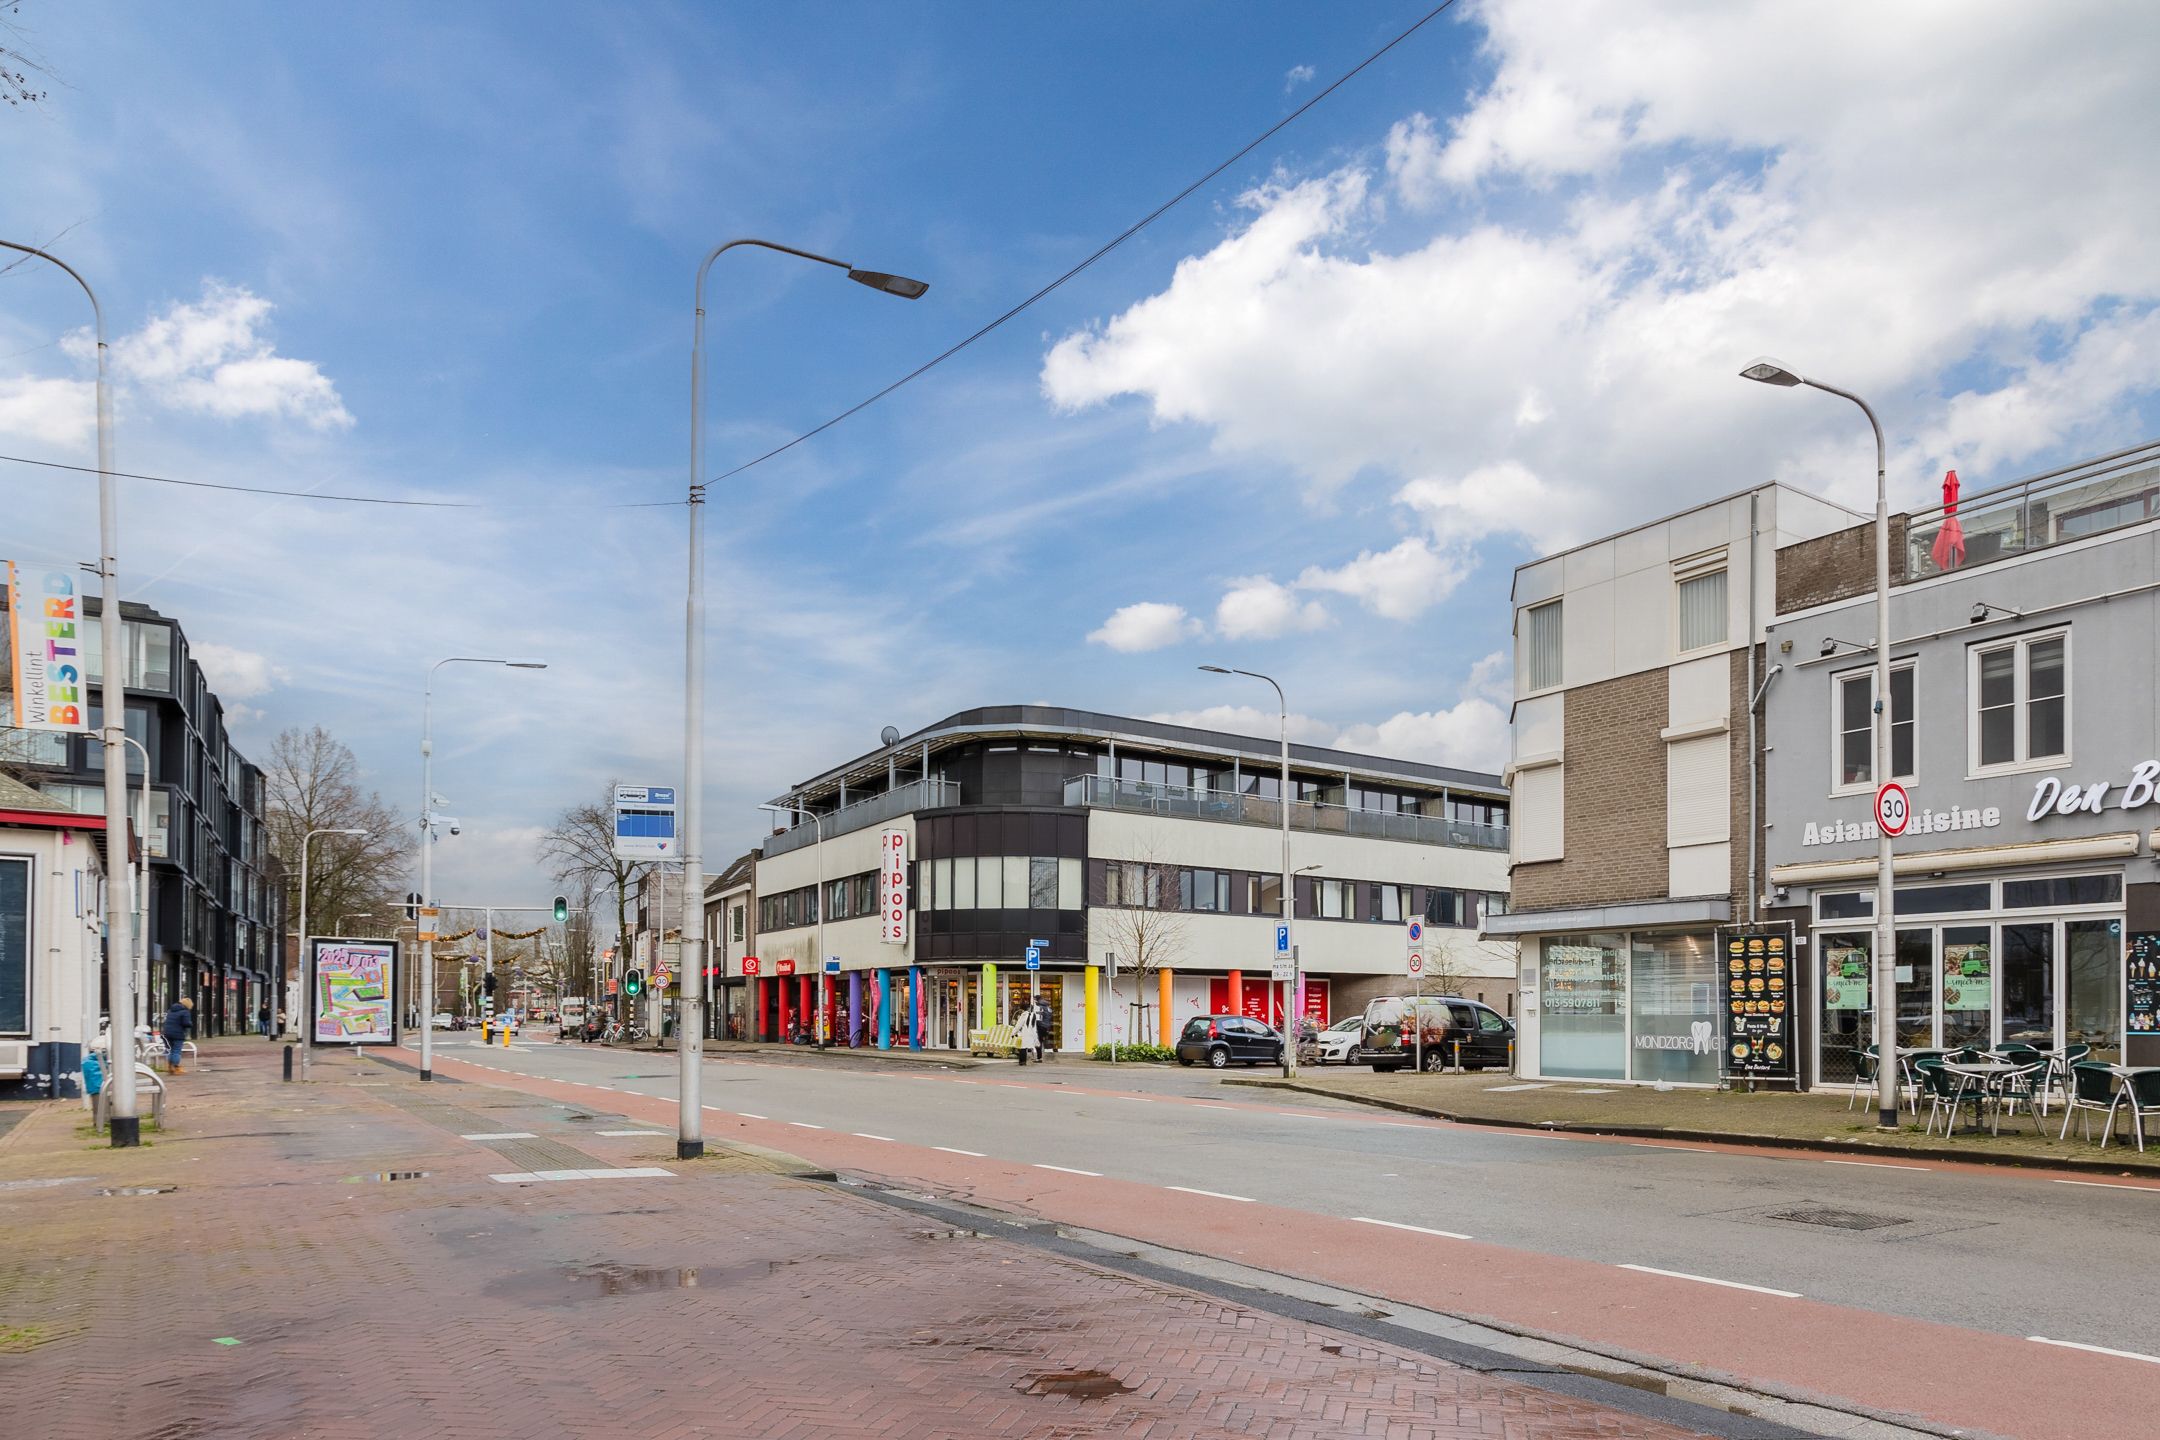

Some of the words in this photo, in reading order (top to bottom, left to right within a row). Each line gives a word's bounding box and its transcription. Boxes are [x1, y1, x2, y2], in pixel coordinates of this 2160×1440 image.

[43, 572, 80, 724] BESTERD
[25, 650, 45, 722] Winkellint
[1883, 799, 1904, 818] 30
[2027, 776, 2110, 821] Den
[2121, 759, 2160, 809] B
[1802, 818, 1880, 846] Asian
[1905, 805, 2000, 836] uisine
[892, 834, 903, 938] pipoos
[1028, 949, 1037, 961] P
[1635, 1035, 1694, 1049] MONDZORG
